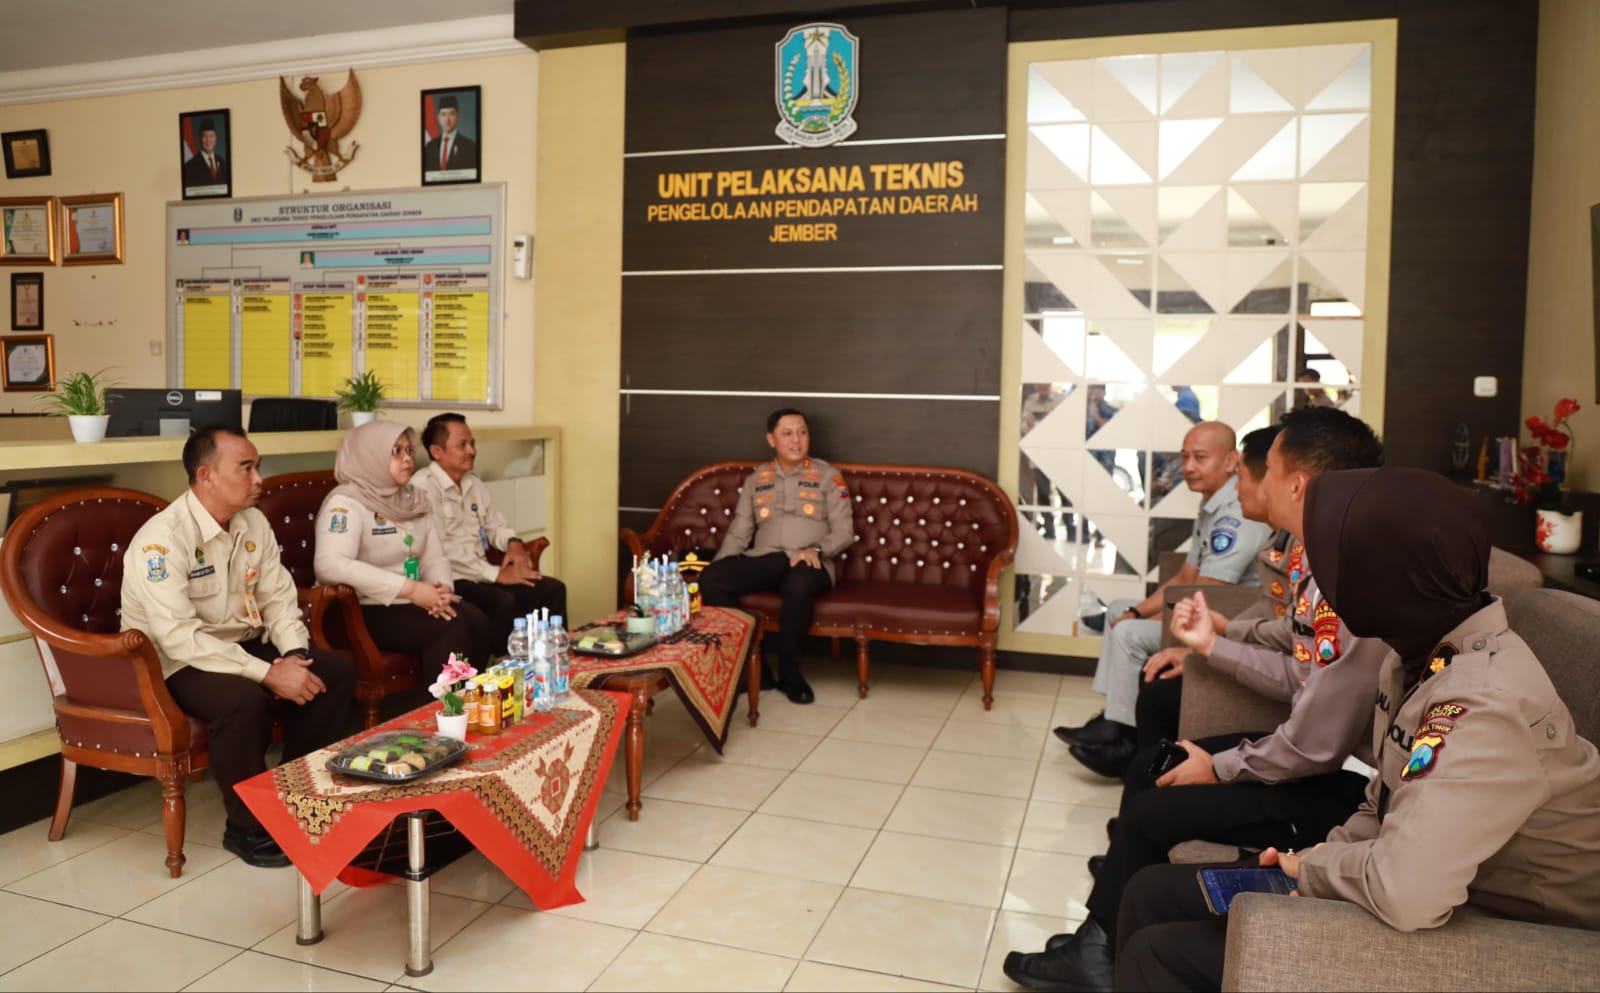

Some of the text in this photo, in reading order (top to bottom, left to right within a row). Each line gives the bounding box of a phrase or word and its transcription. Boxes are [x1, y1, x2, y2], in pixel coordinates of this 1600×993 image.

[658, 160, 965, 198] UNIT PELAKSANA TEKNIS
[279, 201, 392, 215] STRUKTUR ORGANISASI
[648, 193, 978, 222] PENGELOLAAN PENDAPATAN DAERAH
[769, 223, 838, 242] JEMBER
[798, 480, 820, 489] POLRI
